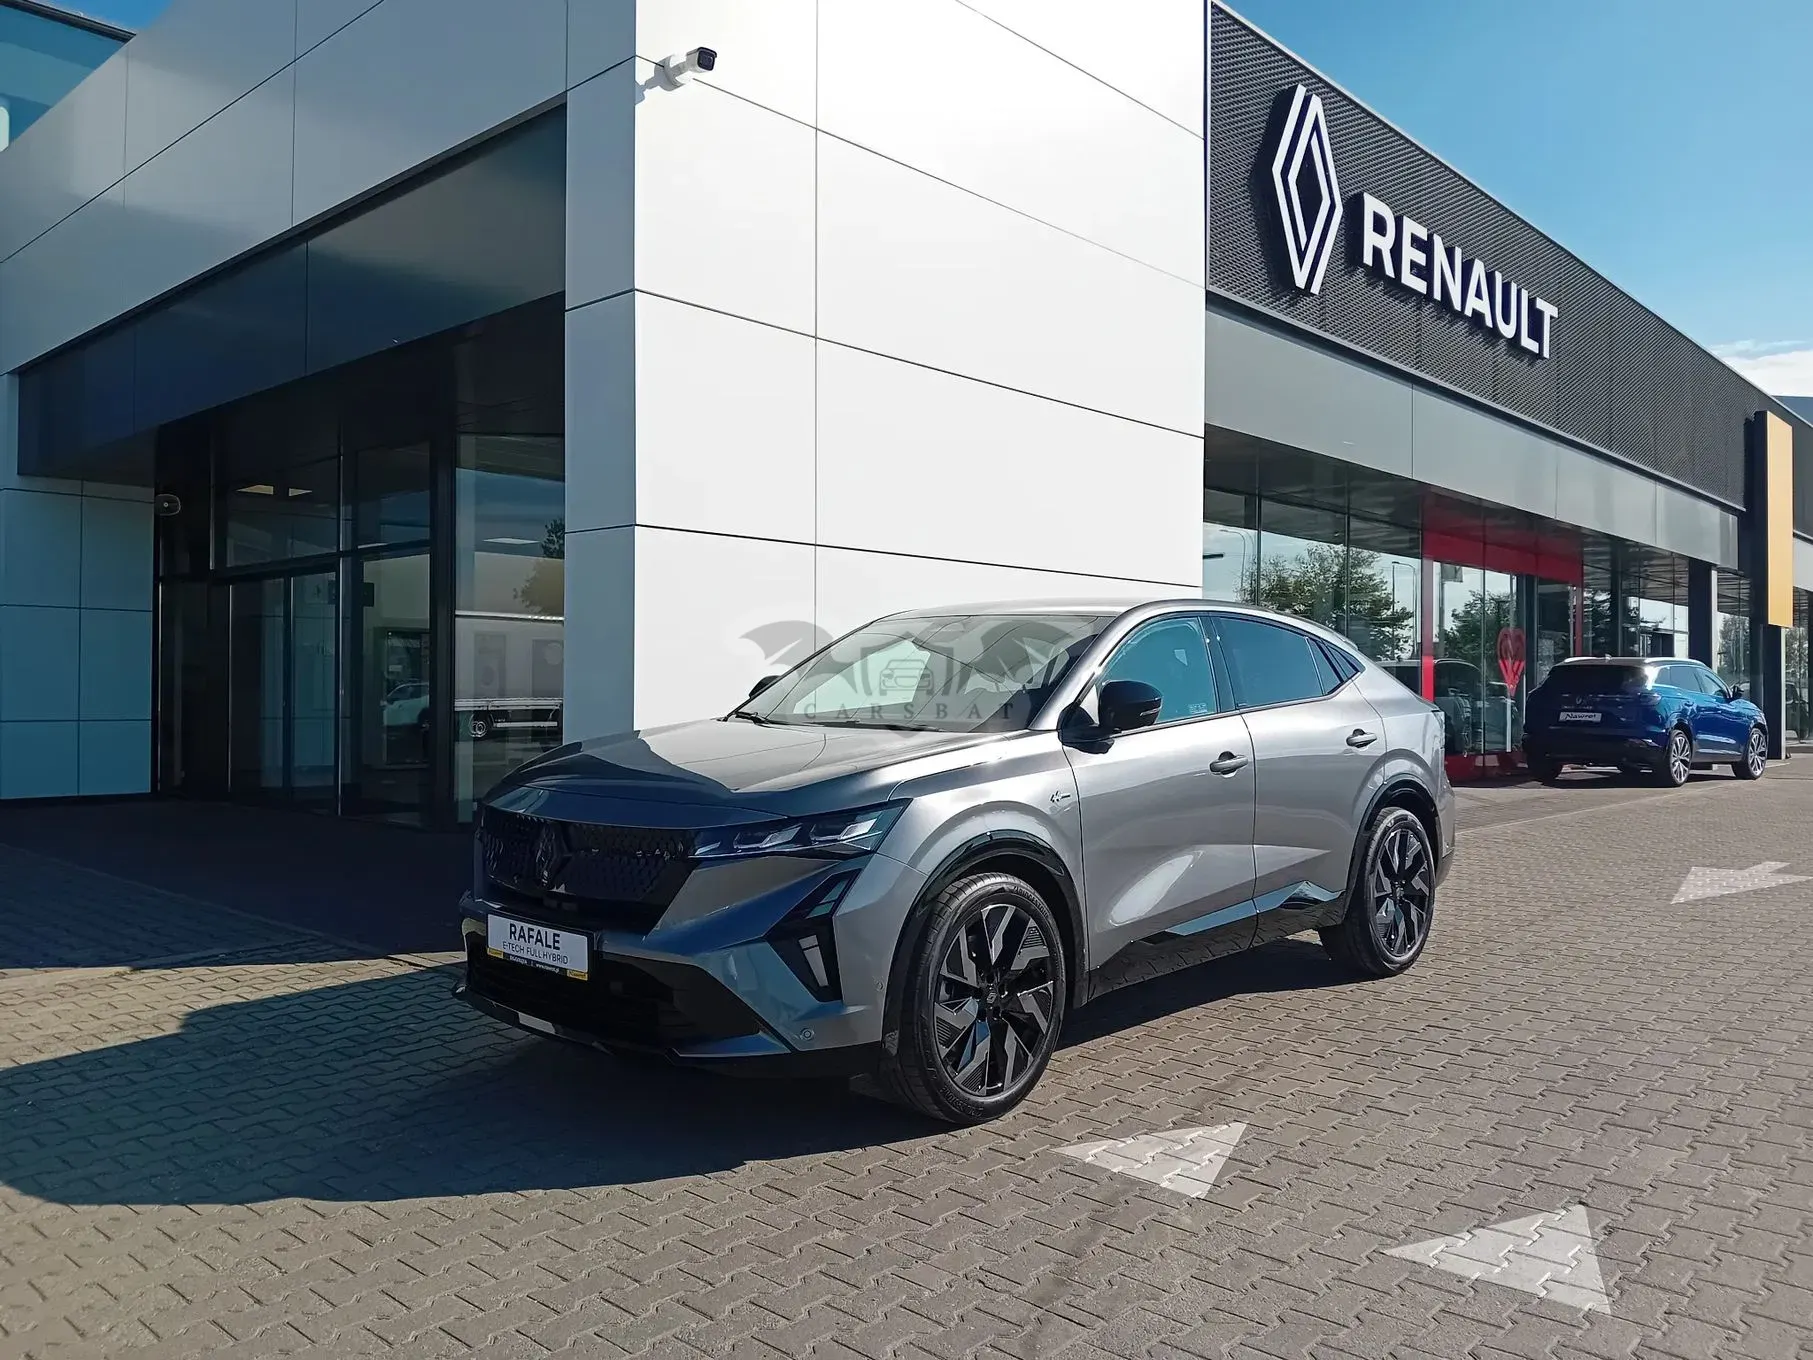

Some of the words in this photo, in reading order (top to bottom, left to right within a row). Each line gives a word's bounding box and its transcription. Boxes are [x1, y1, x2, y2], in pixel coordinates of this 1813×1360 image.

[1362, 191, 1559, 359] RENAULT
[509, 923, 561, 950] RAFALE
[502, 941, 525, 954] E-TECH
[526, 947, 542, 959] FULL
[542, 952, 569, 965] HYBRID
